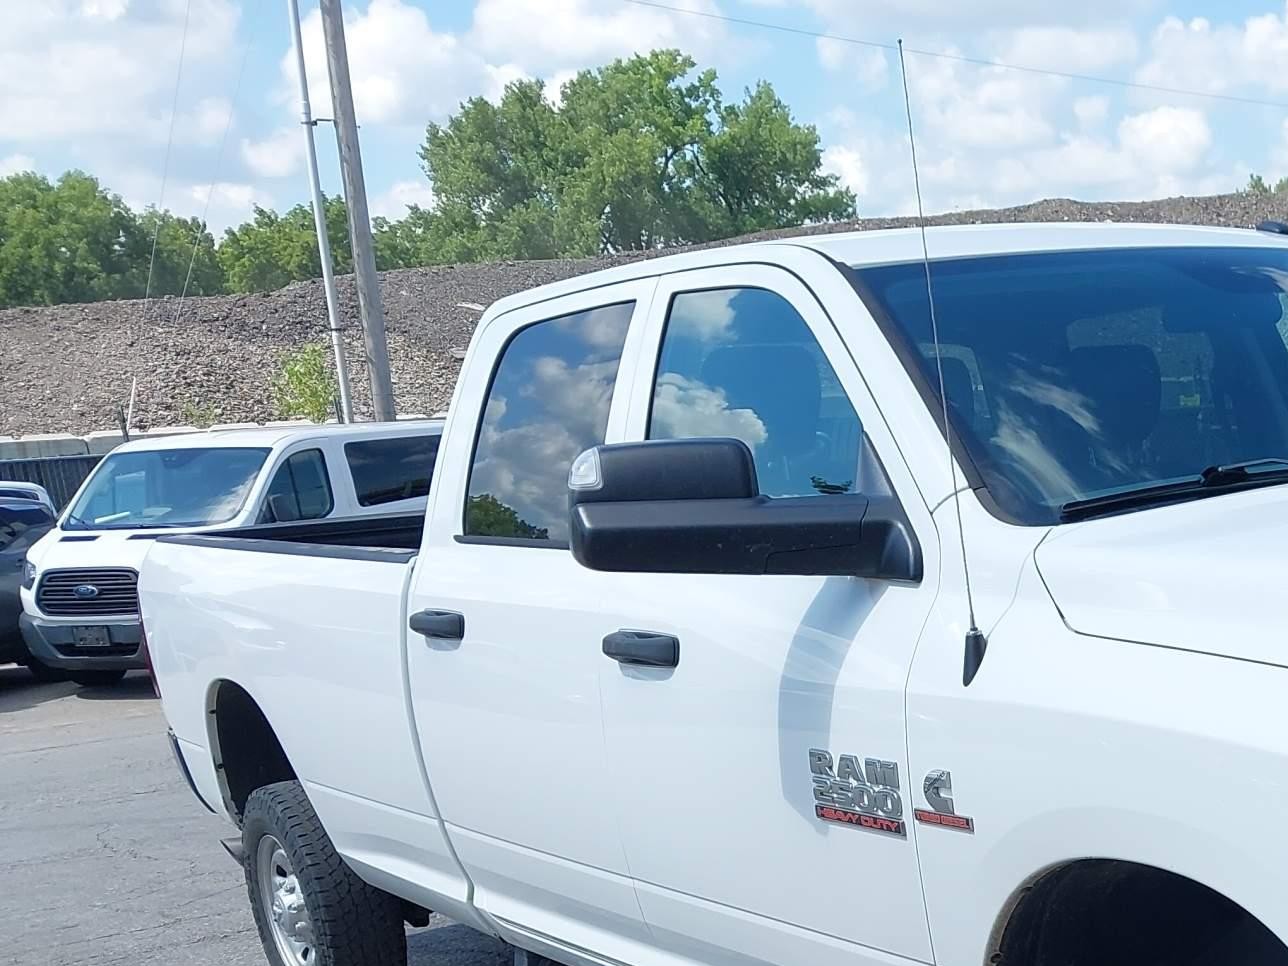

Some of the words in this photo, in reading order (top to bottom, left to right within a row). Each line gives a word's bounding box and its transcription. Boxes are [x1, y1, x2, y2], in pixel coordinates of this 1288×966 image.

[809, 748, 900, 791] RAM
[813, 775, 902, 820] 2500
[818, 807, 861, 824] HEAVY
[861, 814, 898, 832] DUTY
